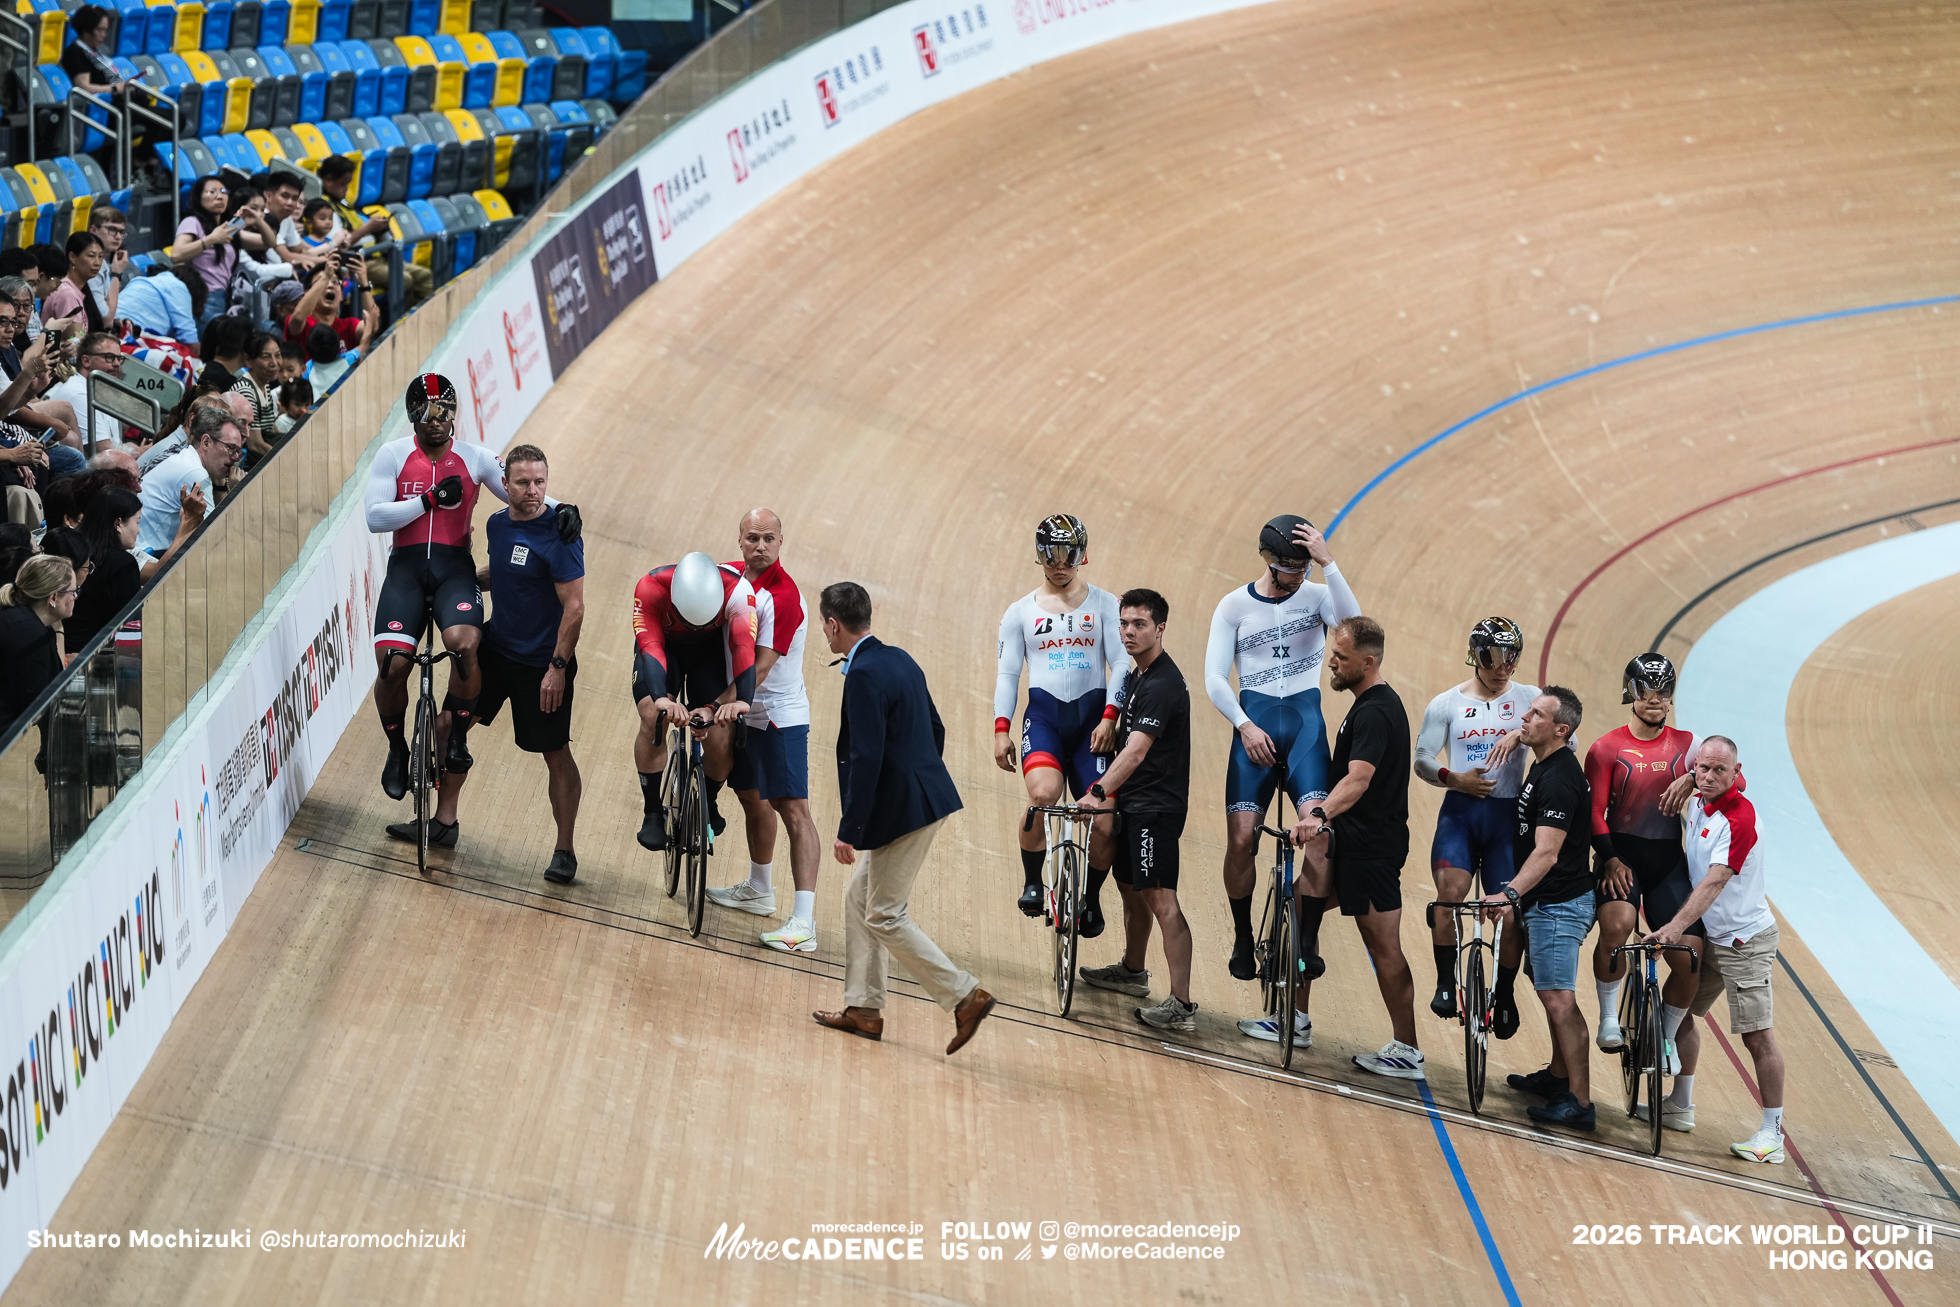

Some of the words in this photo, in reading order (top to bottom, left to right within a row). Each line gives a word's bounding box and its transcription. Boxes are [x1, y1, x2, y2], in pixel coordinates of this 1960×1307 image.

[136, 378, 165, 391] A04
[313, 603, 345, 701] TISSOT
[633, 597, 648, 636] CHINA
[1038, 637, 1095, 650] JAPAN
[273, 662, 305, 768] TISSOT
[1457, 728, 1514, 740] JAPA
[1141, 828, 1149, 877] JAPAN
[105, 909, 135, 1028] UCI
[140, 867, 165, 980] UCI
[71, 954, 102, 1079] UCI
[35, 1003, 68, 1134] UCI
